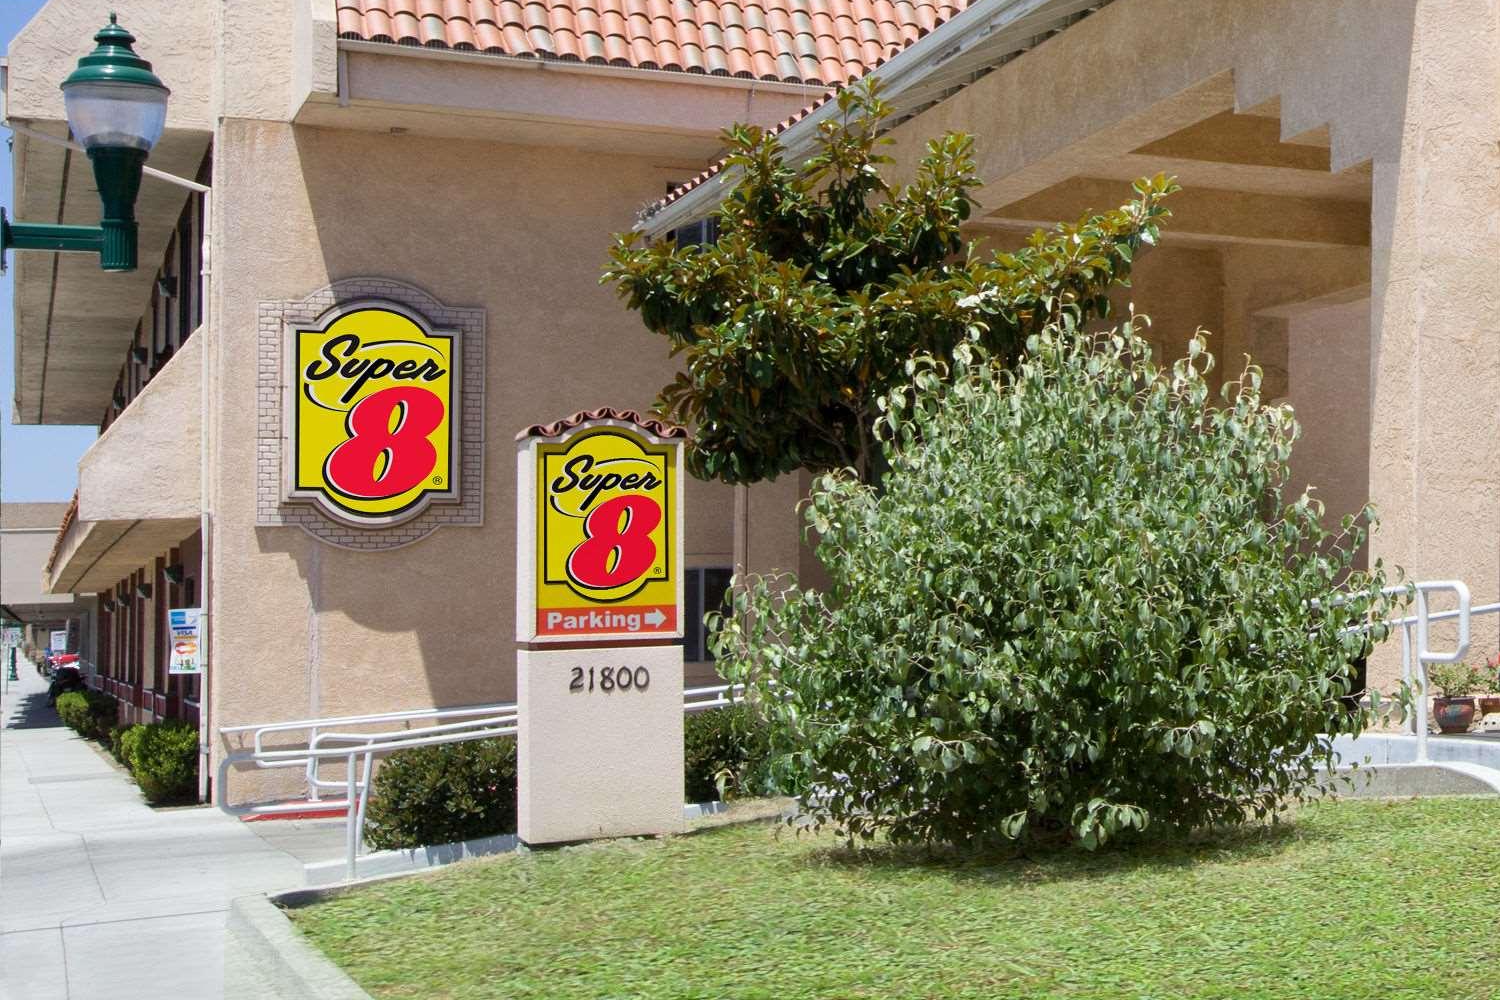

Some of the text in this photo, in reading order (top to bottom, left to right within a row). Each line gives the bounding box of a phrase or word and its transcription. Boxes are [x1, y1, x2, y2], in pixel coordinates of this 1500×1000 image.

[304, 333, 447, 404] Super
[322, 385, 445, 501] 8
[551, 454, 662, 511] Super
[565, 494, 662, 590] 8
[546, 611, 641, 631] Parking
[569, 666, 650, 691] 21800
